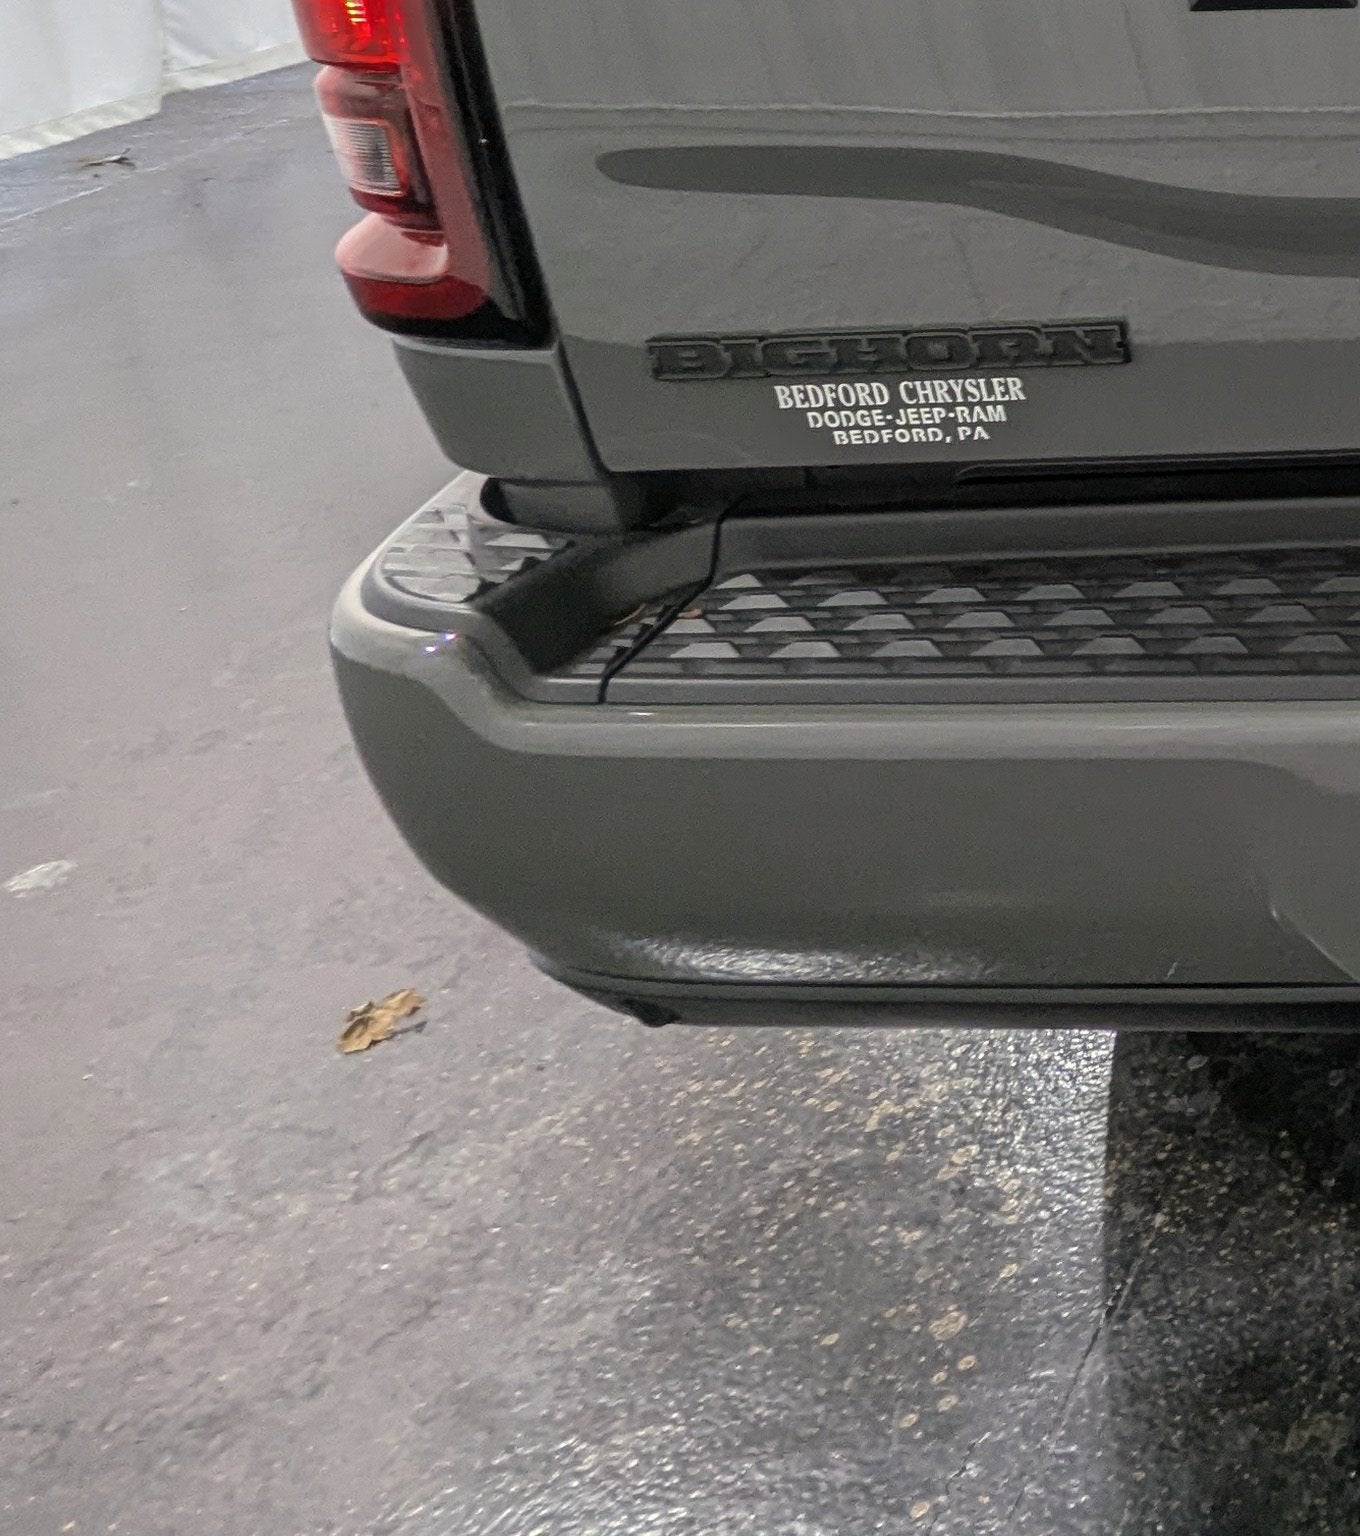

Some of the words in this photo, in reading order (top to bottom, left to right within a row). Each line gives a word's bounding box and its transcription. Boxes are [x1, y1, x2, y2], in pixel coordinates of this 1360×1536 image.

[774, 382, 890, 409] BEDFORD
[899, 377, 1026, 405] CHRYSLER
[833, 427, 952, 445] BEDFORD,
[957, 426, 991, 442] PA
